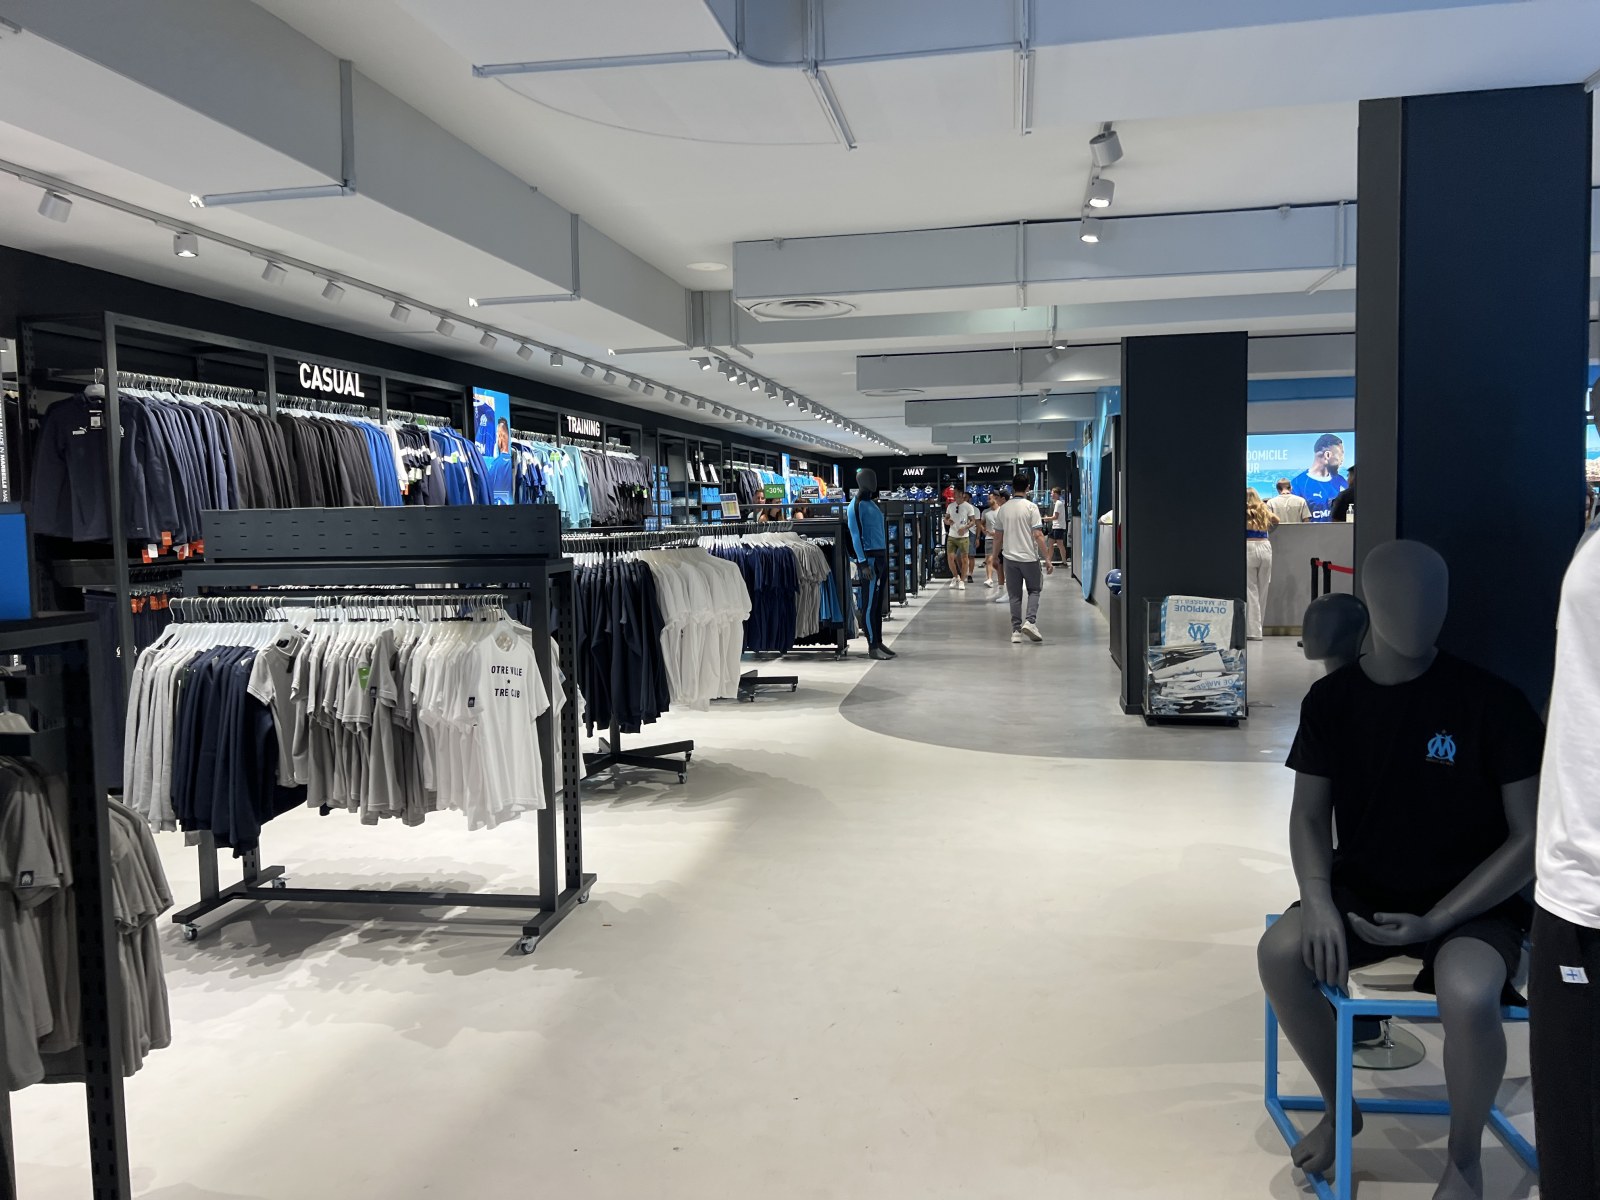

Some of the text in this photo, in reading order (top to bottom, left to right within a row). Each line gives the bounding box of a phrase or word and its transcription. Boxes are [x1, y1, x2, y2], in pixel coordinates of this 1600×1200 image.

[299, 363, 365, 398] CASUAL
[567, 415, 601, 437] TRAINING
[902, 468, 925, 476] AWAY
[977, 465, 1000, 474] AWAY
[1174, 605, 1226, 614] OLYMPIQUE
